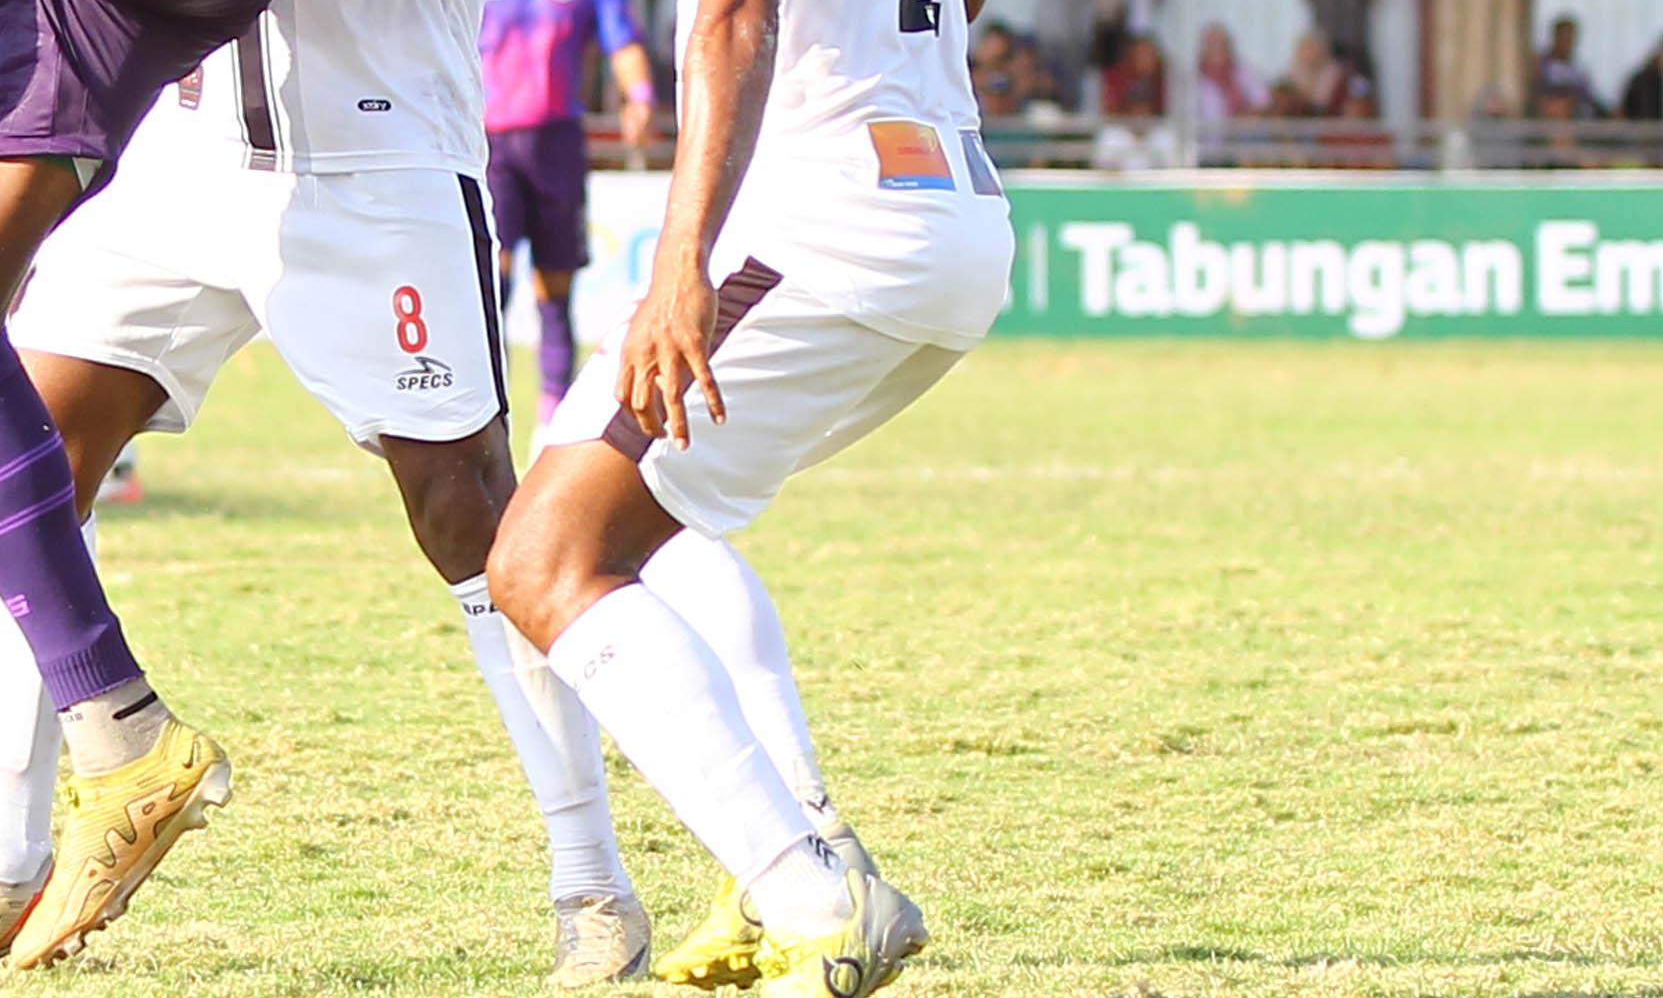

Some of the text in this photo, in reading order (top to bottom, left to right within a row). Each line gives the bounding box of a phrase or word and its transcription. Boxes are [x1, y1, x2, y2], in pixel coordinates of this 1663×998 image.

[1059, 219, 1523, 338] Tabungan
[392, 284, 429, 355] 8
[396, 371, 454, 391] SPECS
